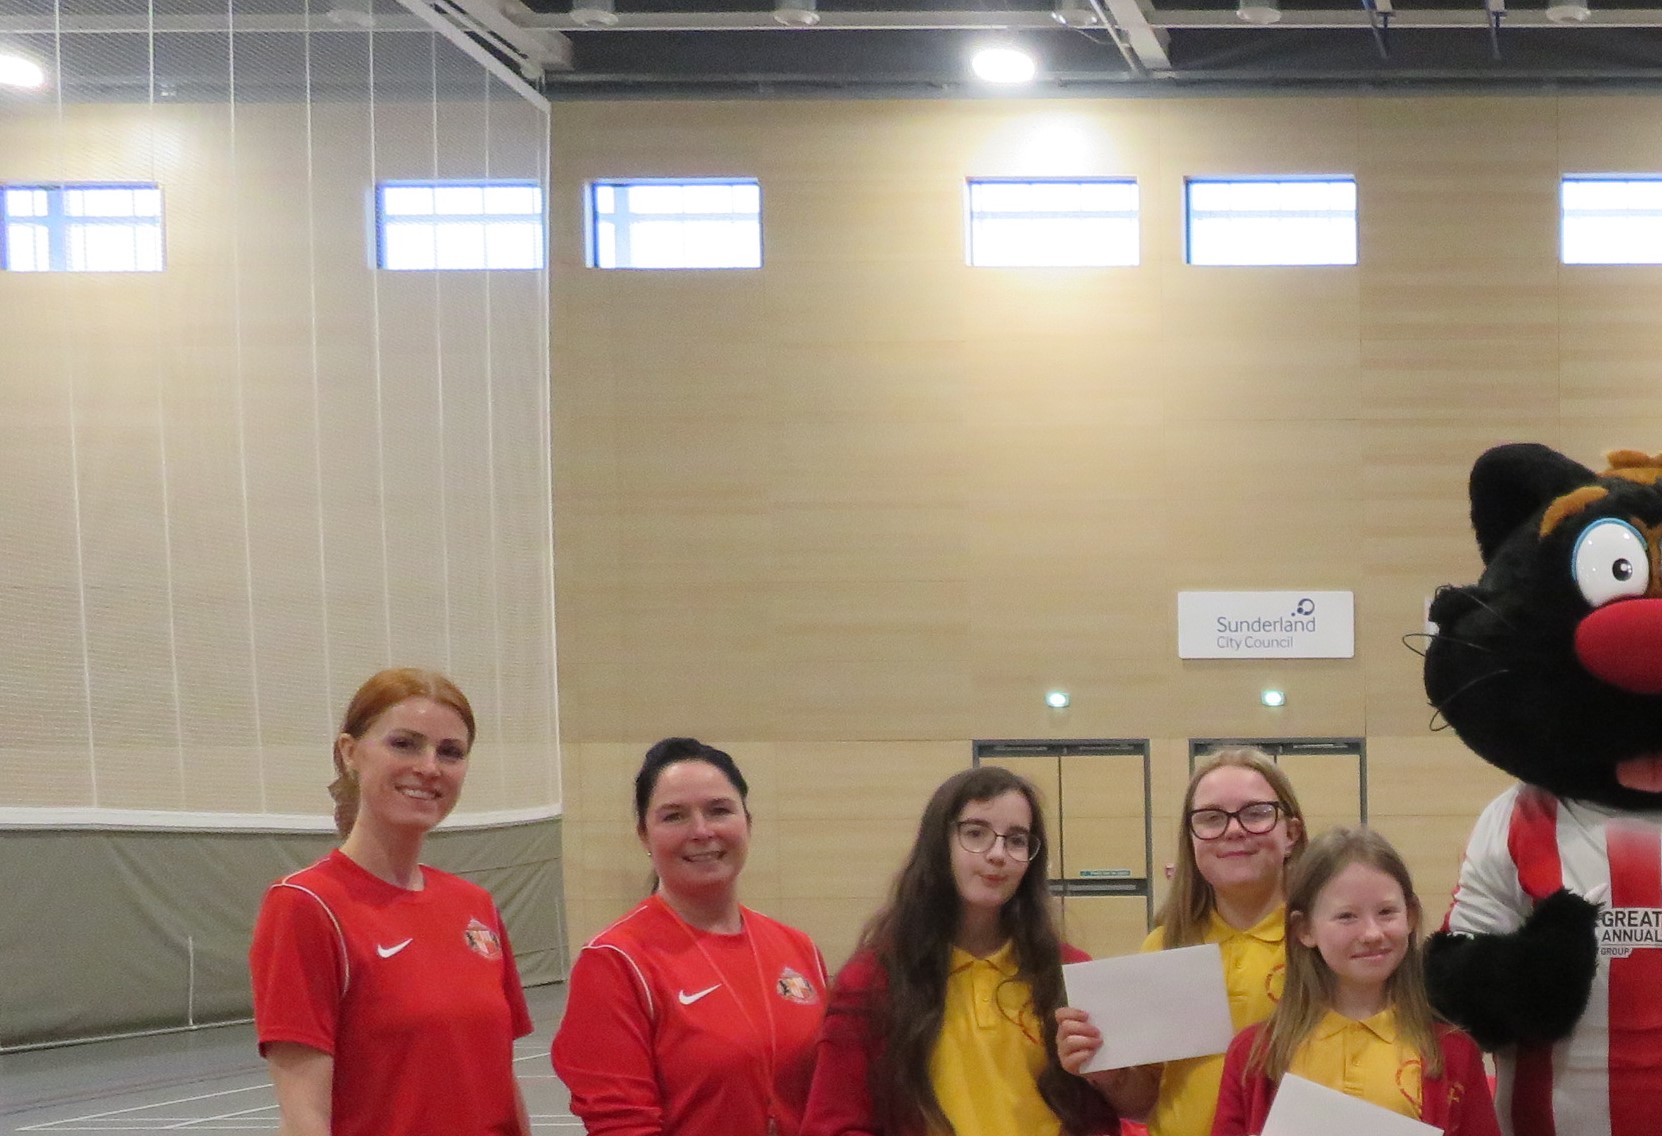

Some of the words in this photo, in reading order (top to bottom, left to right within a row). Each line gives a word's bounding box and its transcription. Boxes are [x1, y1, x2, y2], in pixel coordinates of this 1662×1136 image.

[1216, 616, 1316, 633] Sunderland
[1216, 636, 1242, 650] City
[1244, 636, 1293, 649] Council
[1602, 911, 1662, 928] GREAT
[1602, 929, 1662, 943] ANNUAL
[1600, 947, 1630, 956] GROUP
